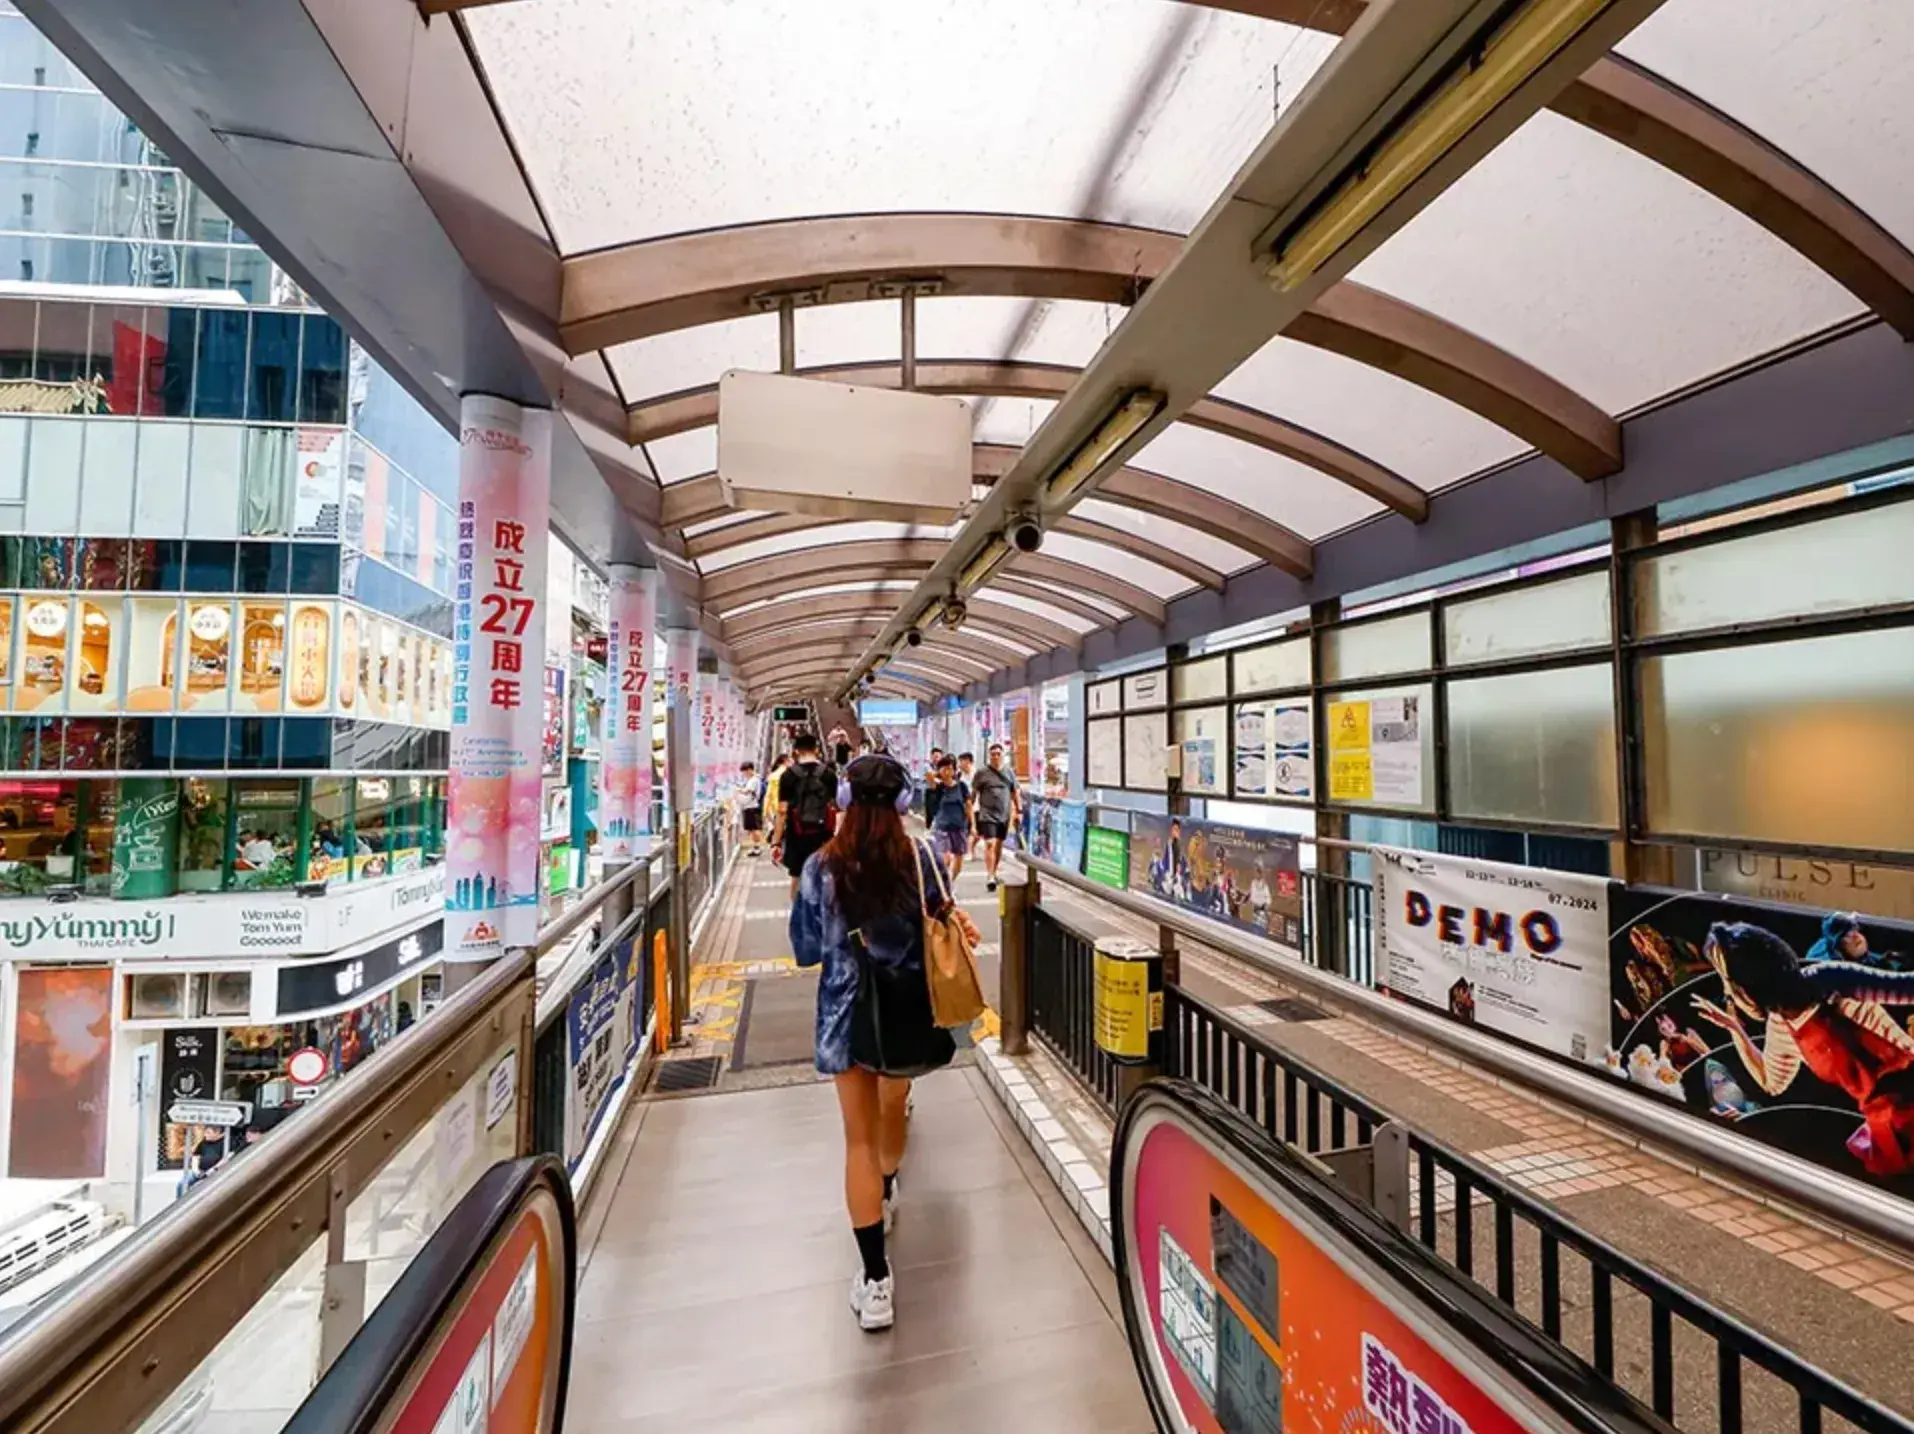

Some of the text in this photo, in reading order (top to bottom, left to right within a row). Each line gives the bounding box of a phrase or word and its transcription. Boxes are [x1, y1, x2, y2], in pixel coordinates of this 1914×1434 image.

[480, 520, 535, 710] 成立27周年
[1703, 849, 1875, 890] PULSE
[1404, 889, 1563, 955] DEMO
